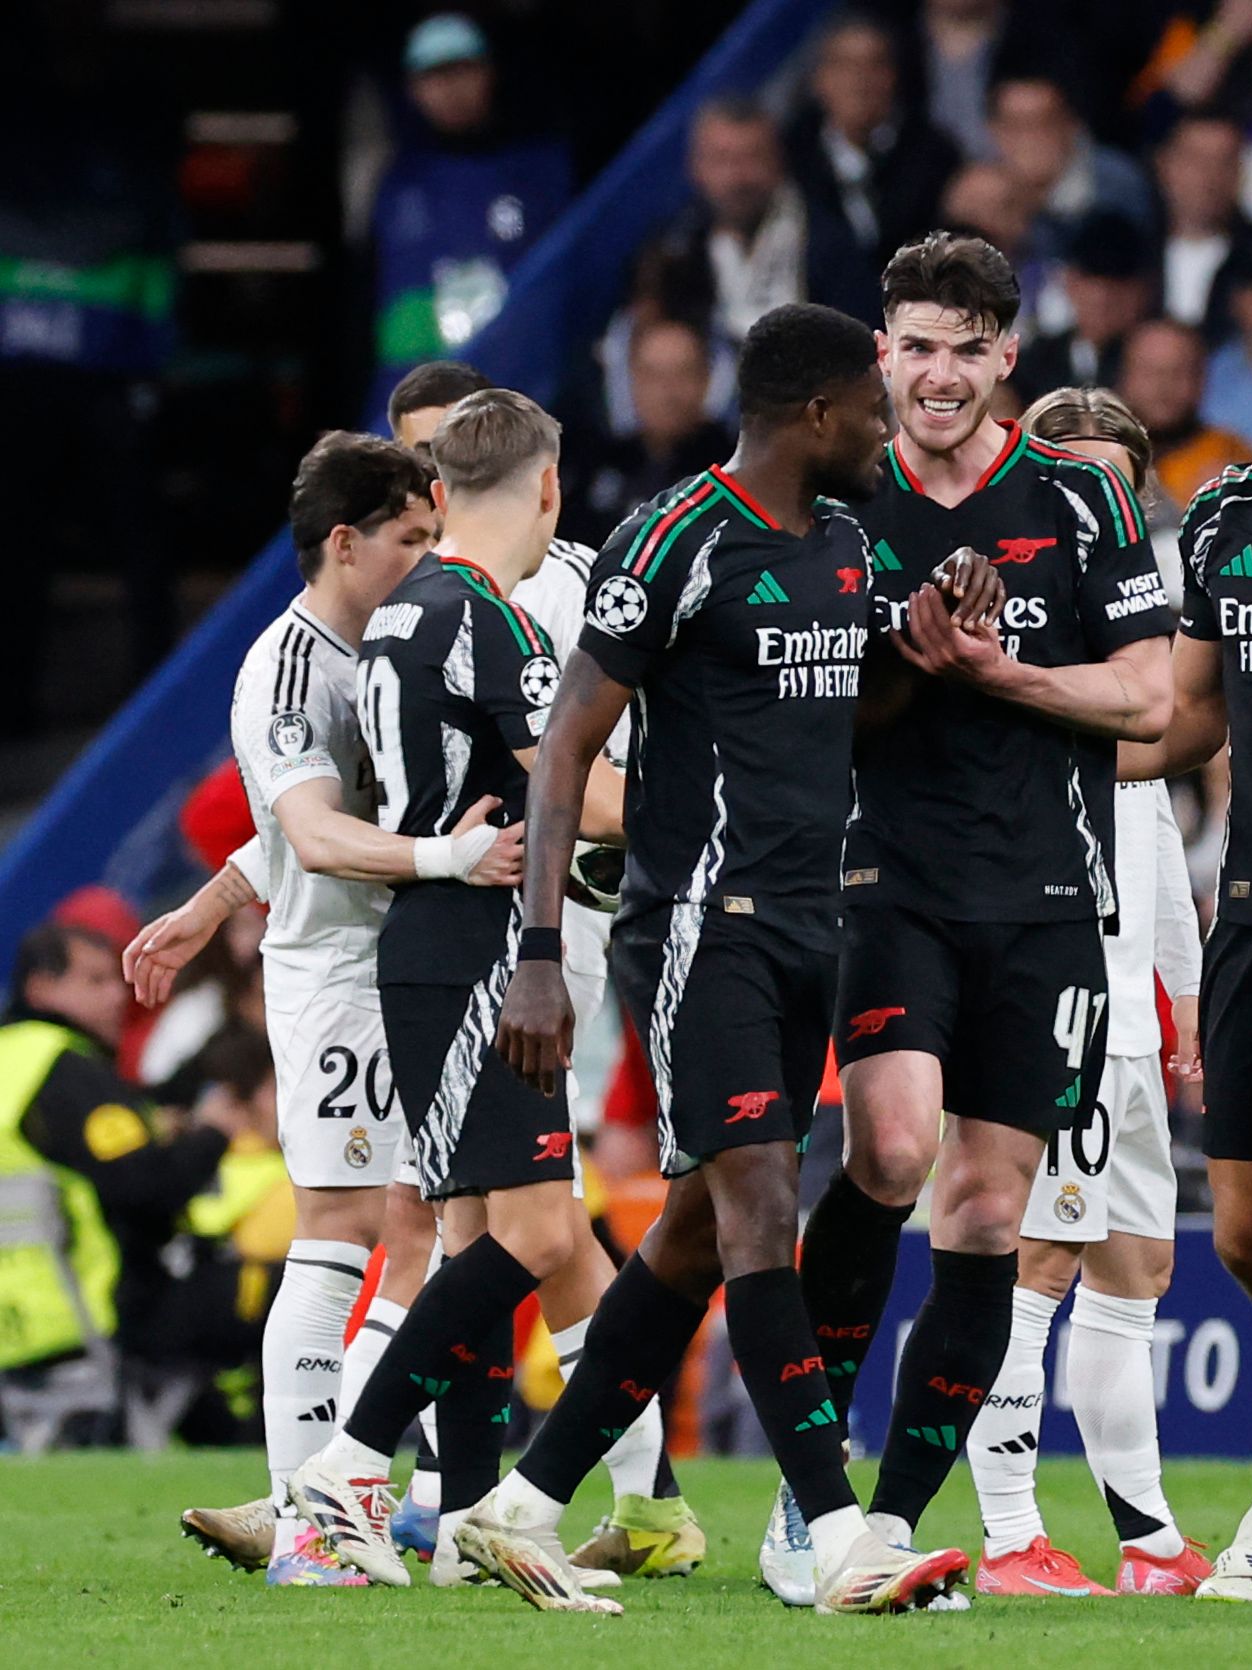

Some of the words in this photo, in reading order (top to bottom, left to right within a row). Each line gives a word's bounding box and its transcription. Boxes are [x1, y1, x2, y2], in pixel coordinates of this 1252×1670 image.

[1117, 571, 1160, 597] VISIT
[1104, 588, 1169, 620] RWAND
[778, 667, 808, 700] FLY
[813, 665, 860, 698] BETTER
[283, 733, 298, 745] 15
[317, 1045, 397, 1122] 20
